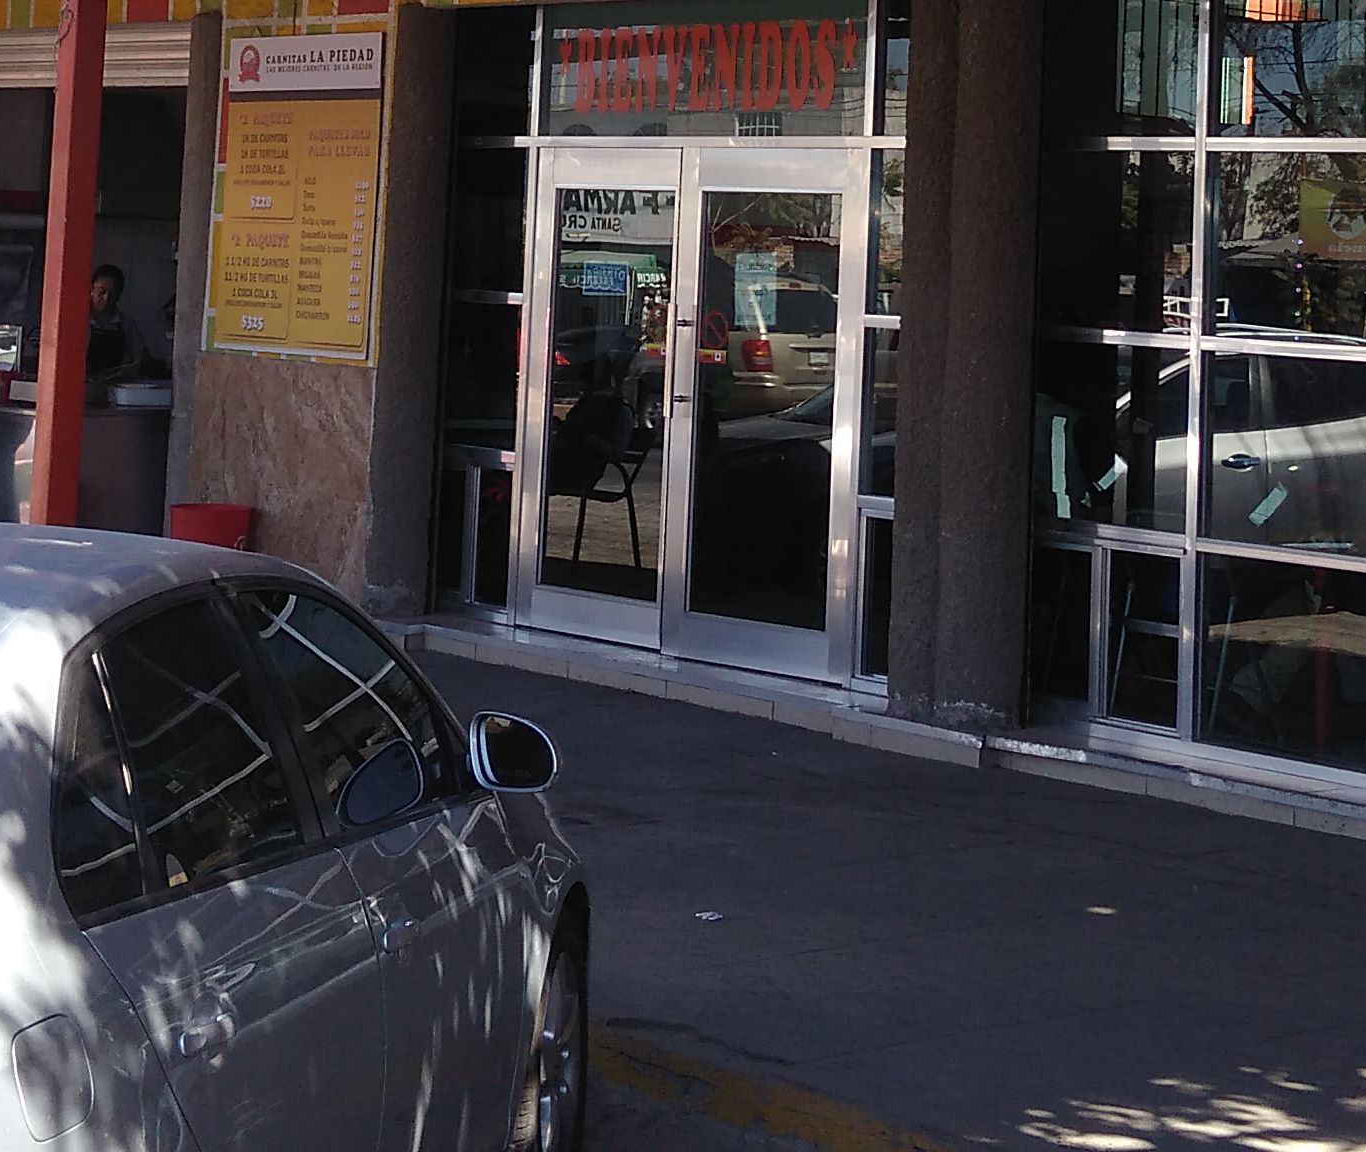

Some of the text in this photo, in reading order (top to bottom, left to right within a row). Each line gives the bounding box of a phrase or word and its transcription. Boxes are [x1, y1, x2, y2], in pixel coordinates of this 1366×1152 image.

[266, 48, 374, 65] CARNITAS LA PIEDAD
[277, 65, 301, 73] MEJORES
[302, 64, 330, 73] CARNITAS
[574, 18, 836, 113] BIENVENIDOS
